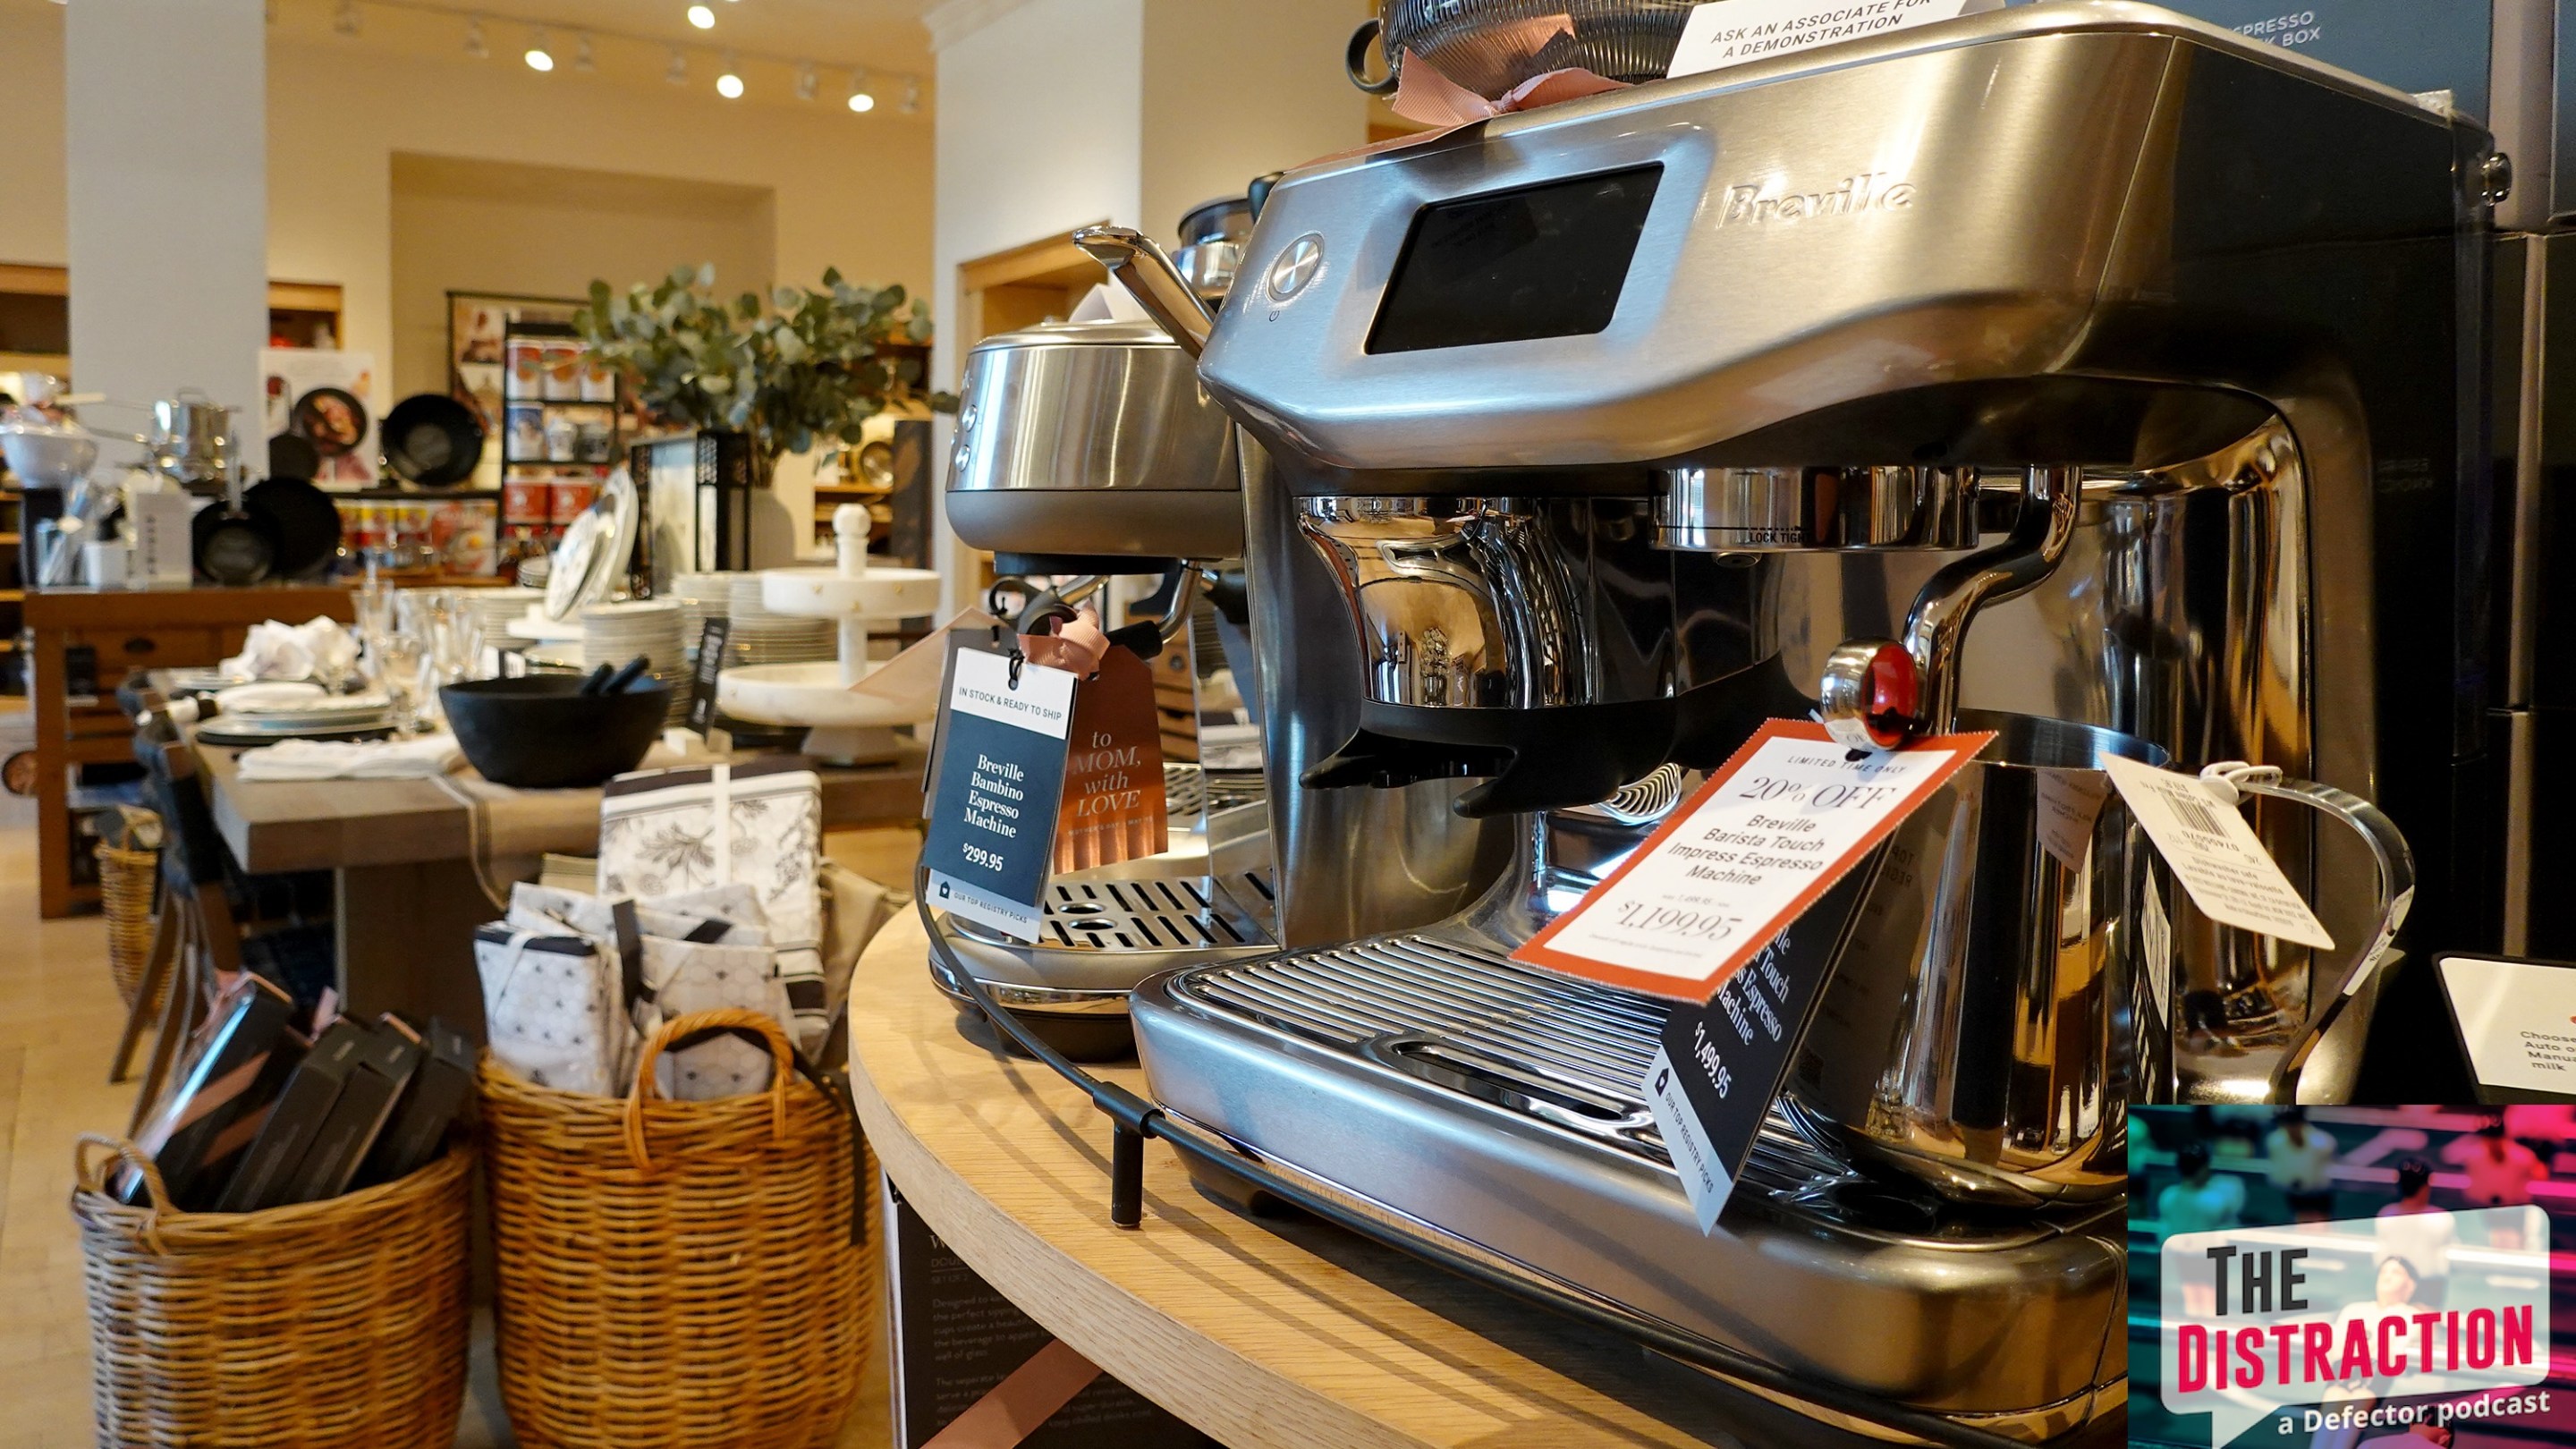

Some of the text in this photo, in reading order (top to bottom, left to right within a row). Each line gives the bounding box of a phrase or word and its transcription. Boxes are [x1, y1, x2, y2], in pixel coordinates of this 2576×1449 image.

[1711, 28, 1749, 44] ASK
[1750, 22, 1778, 38] AN
[1782, 2, 1889, 31] ASSOCIATE
[1723, 13, 1903, 58] A DEMONSTRATION
[2283, 26, 2321, 47] BOX
[1716, 171, 1917, 229] Breville
[1750, 532, 1777, 543] LOCK
[959, 686, 1062, 721] IN STOCK & READY TO SHIP
[1091, 731, 1112, 749] to
[977, 754, 1024, 782] Breville
[1072, 746, 1141, 775] MOM,
[1788, 756, 1907, 774] LIMITED TIME ONLY
[970, 771, 1024, 801] Bambino
[1085, 771, 1128, 794] with
[1740, 776, 1896, 809] 20% OFF
[968, 790, 1020, 819] Espresso
[1077, 790, 1140, 817] LOVE
[963, 808, 1017, 839] Machine
[1746, 814, 1817, 833] Breville
[1703, 828, 1825, 852] Barista Touch
[962, 842, 1004, 872] $299.95
[1668, 843, 1824, 872] Impress Espresso
[1686, 865, 1762, 886] Machine
[953, 892, 1028, 924] OUR TOP REGISTRY PICKS
[1614, 900, 1743, 941] $1,199.95
[1760, 946, 1789, 1004] Touch
[1742, 969, 1783, 1042] Espresso
[1694, 1021, 1732, 1098] $1,499.95
[2525, 1041, 2560, 1051] Auto
[2531, 1063, 2566, 1071] milk
[1665, 1092, 1714, 1193] OUR TOP REGISTRY PICKS
